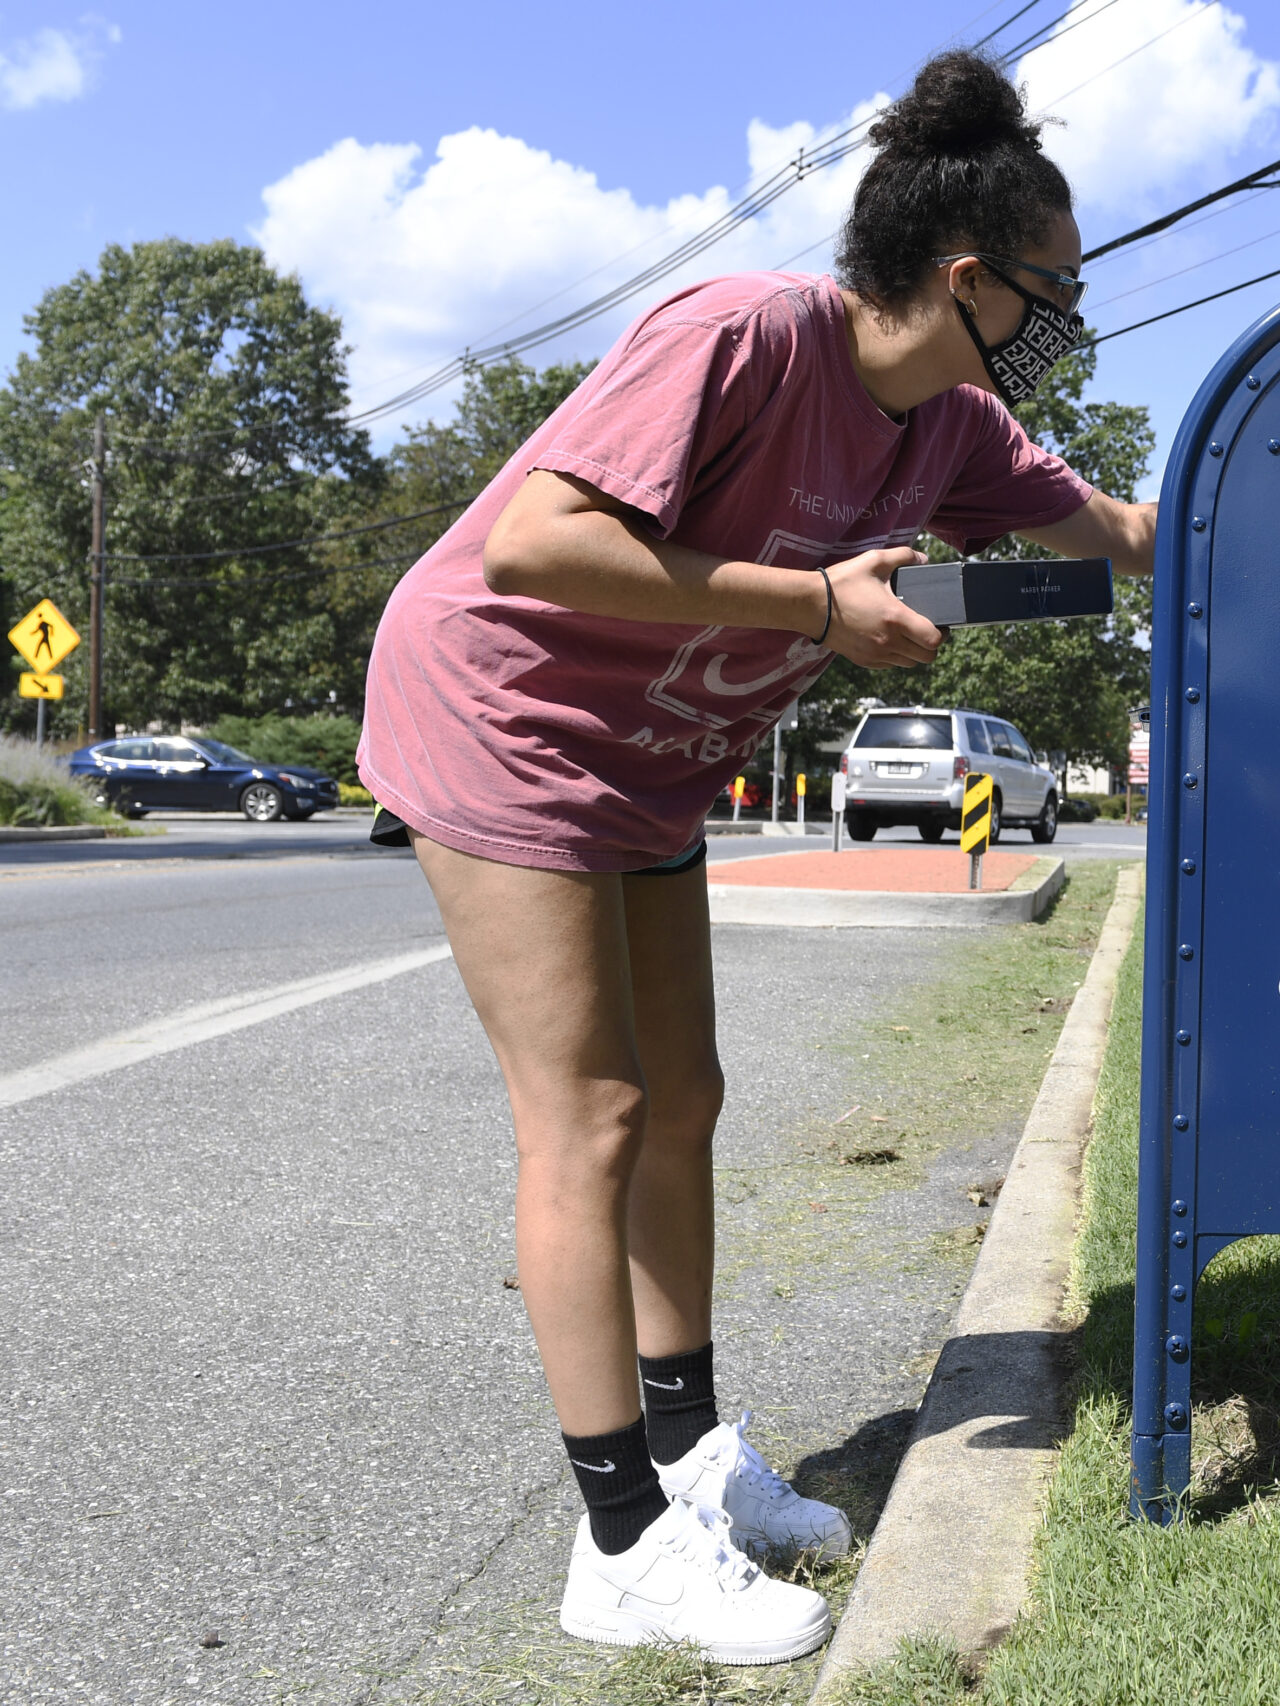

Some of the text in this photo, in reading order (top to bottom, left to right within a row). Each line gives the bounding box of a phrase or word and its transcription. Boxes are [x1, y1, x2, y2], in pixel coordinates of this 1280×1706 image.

[789, 485, 925, 522] THE UNIVSITY OF
